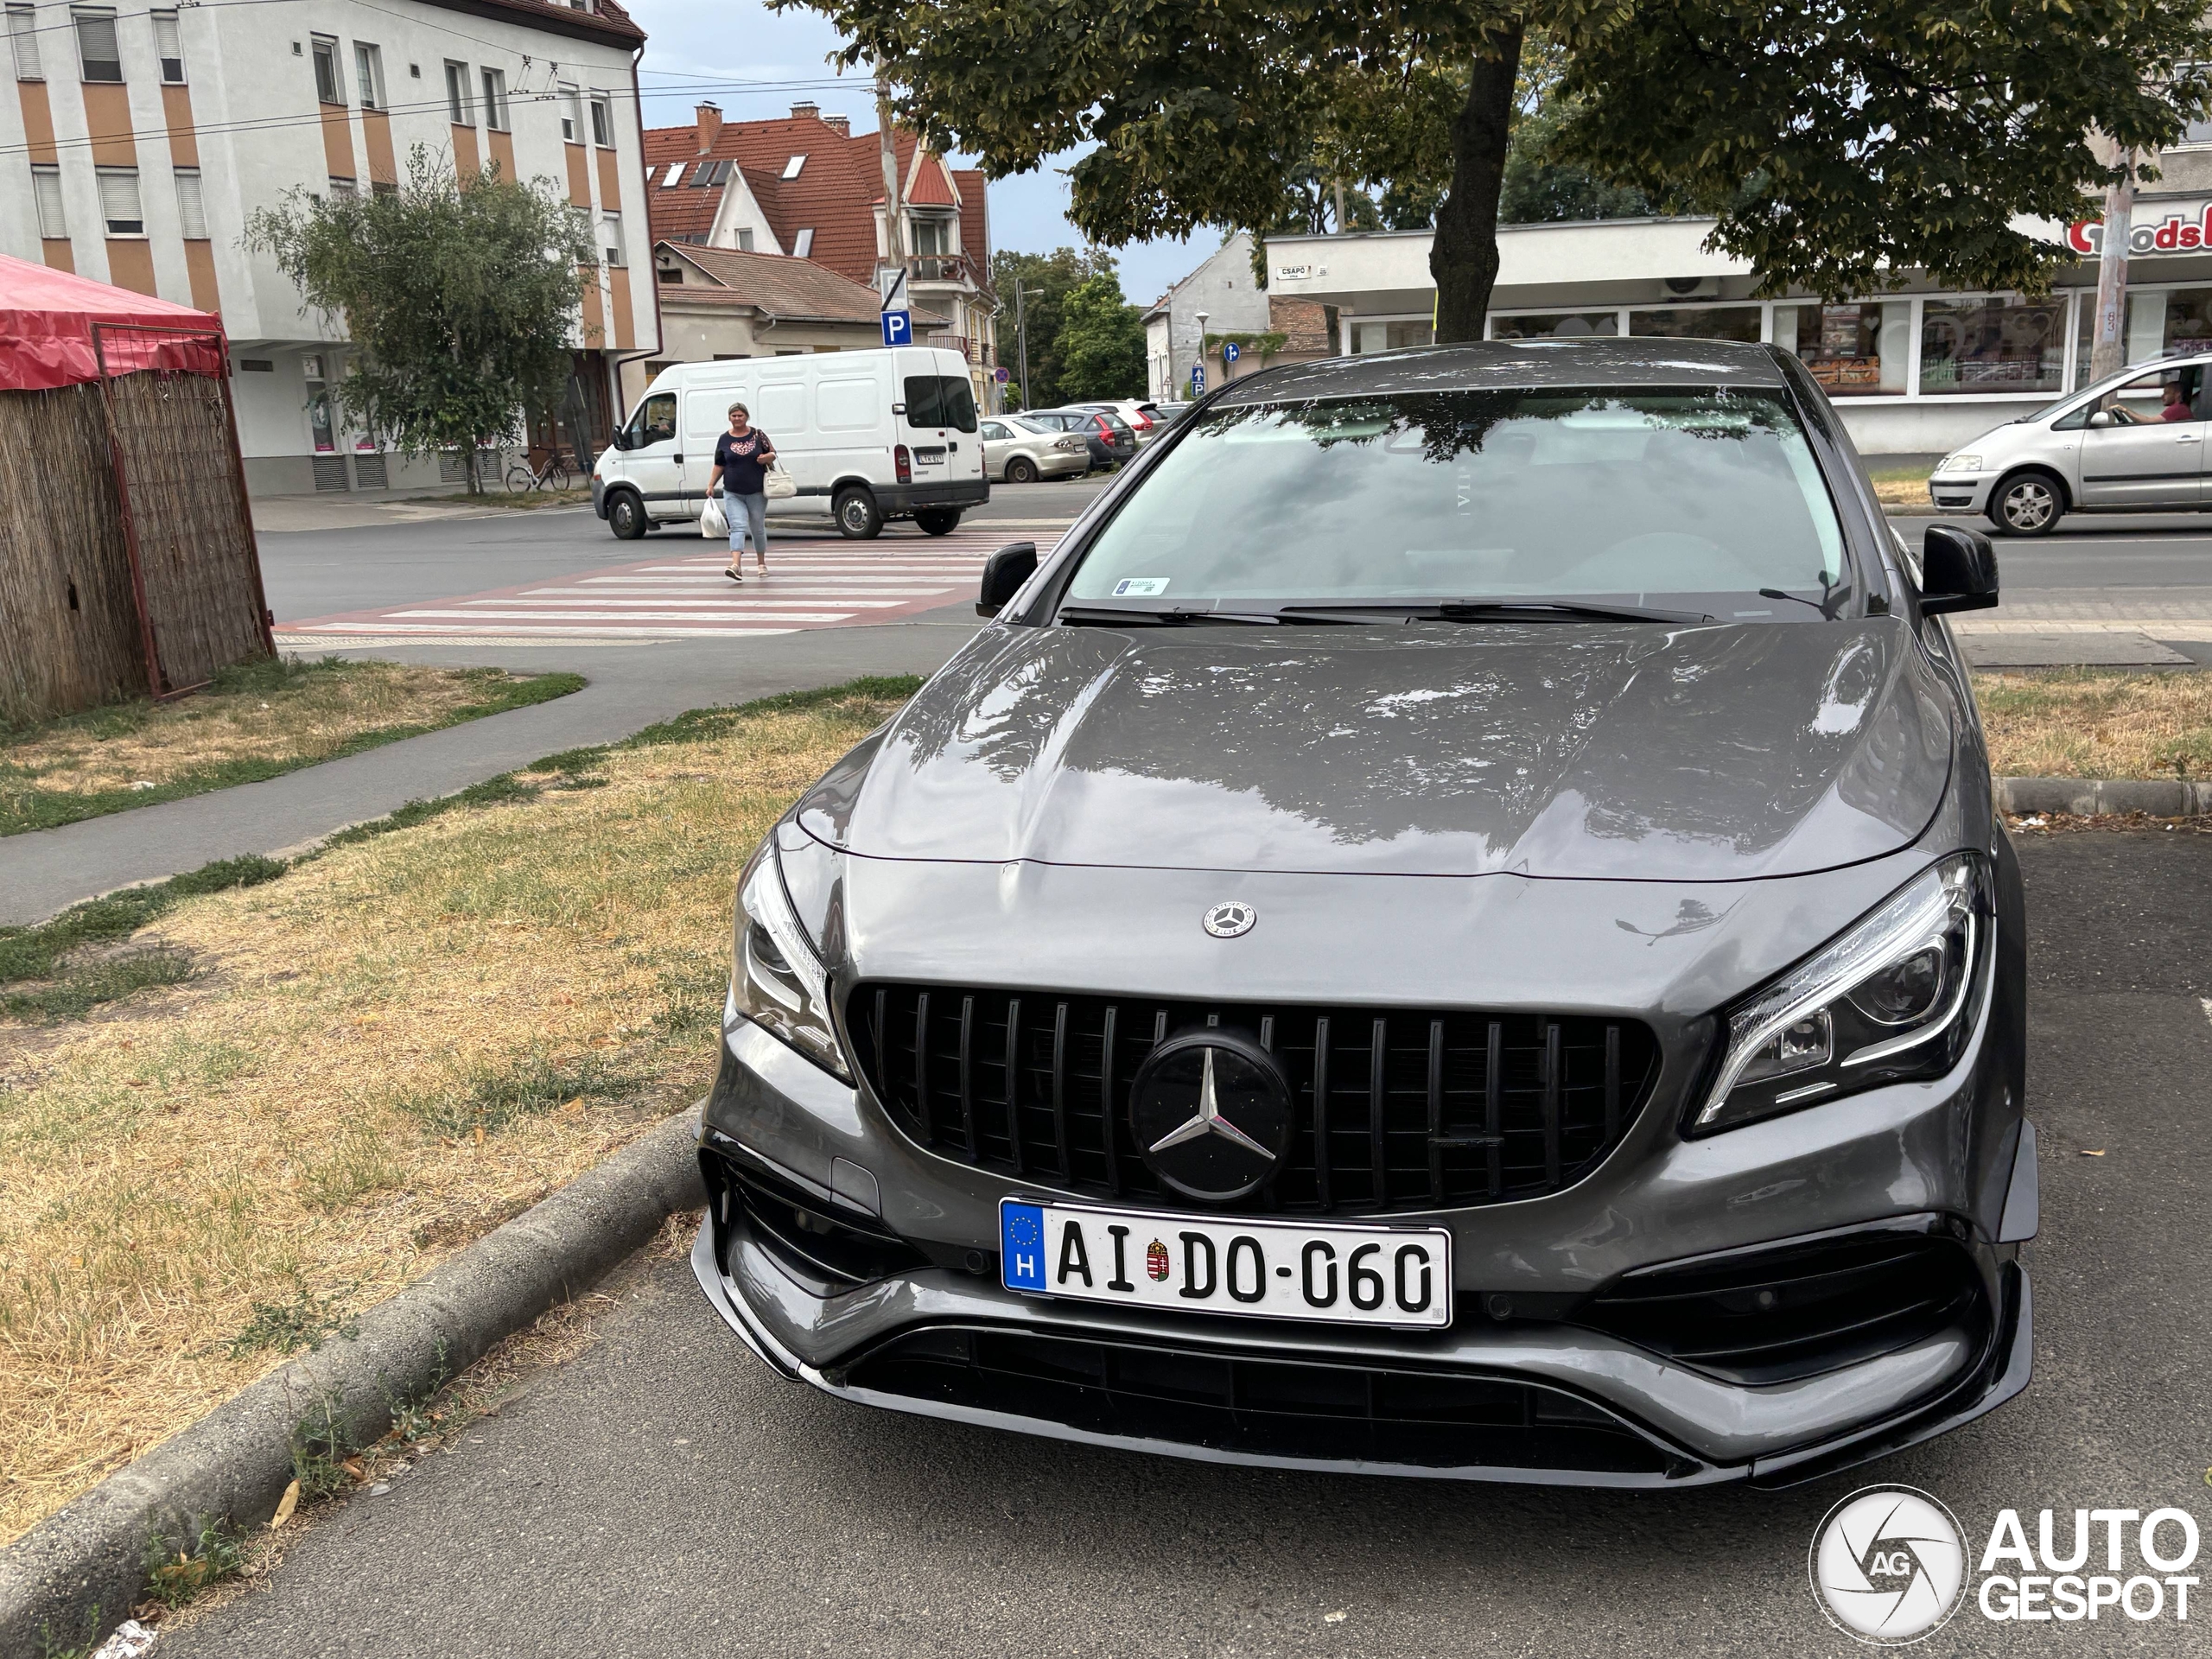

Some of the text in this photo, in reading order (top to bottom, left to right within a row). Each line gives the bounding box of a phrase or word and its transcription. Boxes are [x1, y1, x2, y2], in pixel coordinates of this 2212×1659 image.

[888, 315, 905, 341] P
[1195, 385, 1204, 396] P
[1017, 1255, 1036, 1278] H
